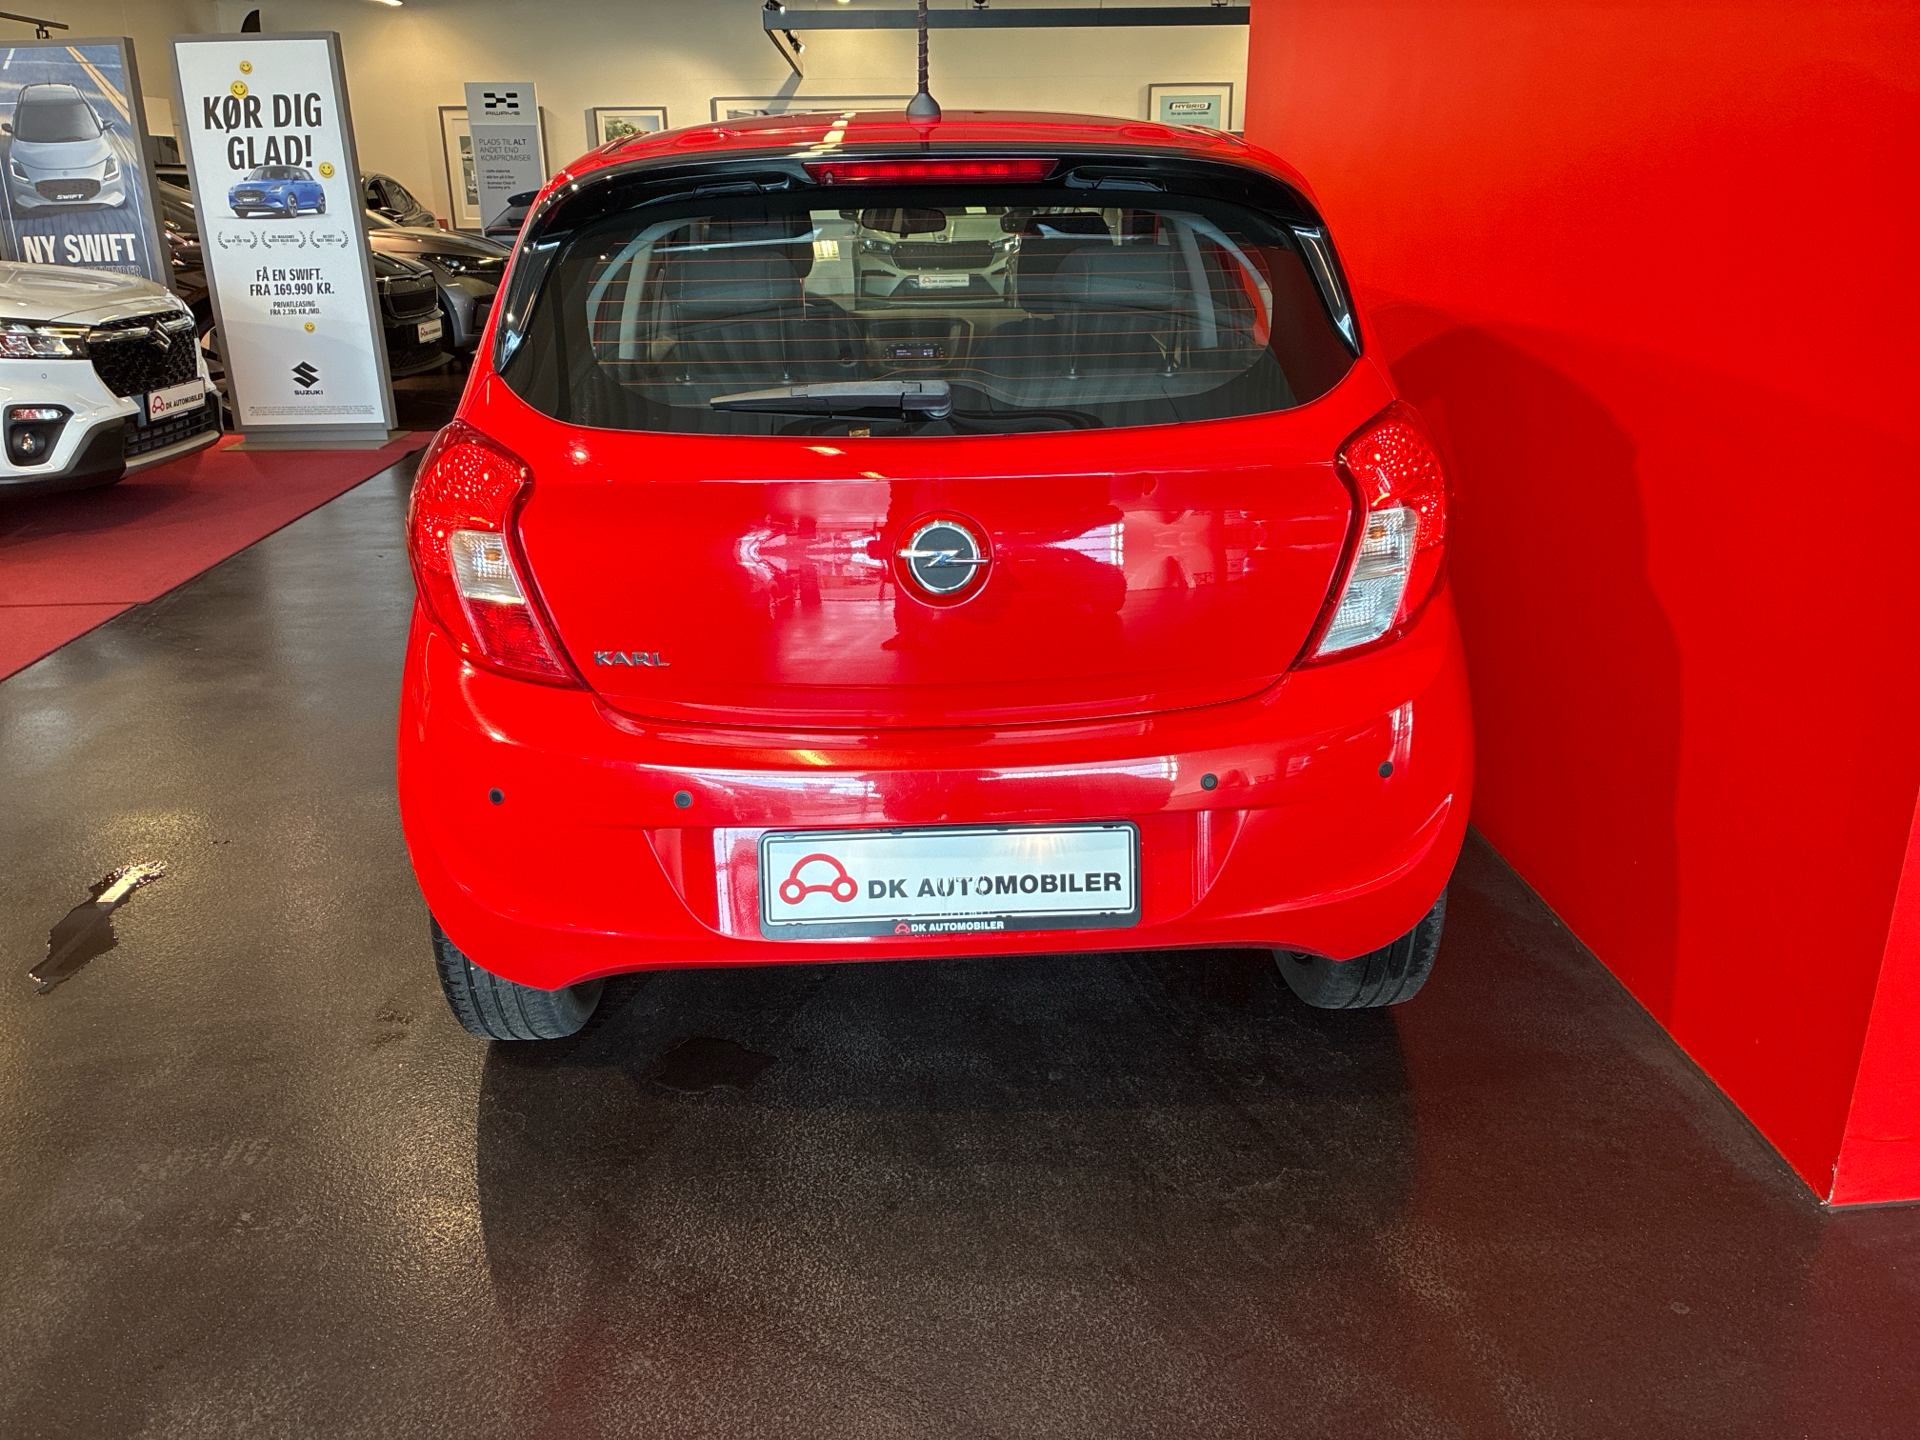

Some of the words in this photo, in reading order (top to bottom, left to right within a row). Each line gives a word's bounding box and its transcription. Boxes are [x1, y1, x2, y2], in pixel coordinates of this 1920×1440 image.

[203, 94, 263, 133] KØR
[272, 92, 322, 128] DIG
[479, 138, 501, 146] PLADS
[502, 138, 512, 146] TIL
[513, 138, 527, 146] ALT
[227, 134, 313, 171] GLAD!
[480, 146, 503, 154] ANDET
[504, 146, 519, 154] END
[480, 154, 532, 162] KOMPROMISER
[22, 234, 56, 264] NY
[63, 233, 136, 264] SWIFT
[256, 266, 270, 282] FÅ
[272, 268, 286, 281] EN
[289, 268, 324, 281] SWIFT.
[249, 284, 271, 296] FRA
[273, 282, 313, 296] 169.990
[317, 282, 335, 295] KR.
[272, 300, 316, 308] PRIVATLEASING
[269, 308, 281, 316] FRA
[165, 401, 173, 409] DK
[173, 392, 204, 407] AUTOMOBILER
[593, 651, 670, 667] KARL
[867, 879, 909, 899] DK
[916, 872, 1122, 898] AUTOMOBILER
[910, 923, 927, 933] DK
[928, 921, 1005, 932] AUTOMOBILER
